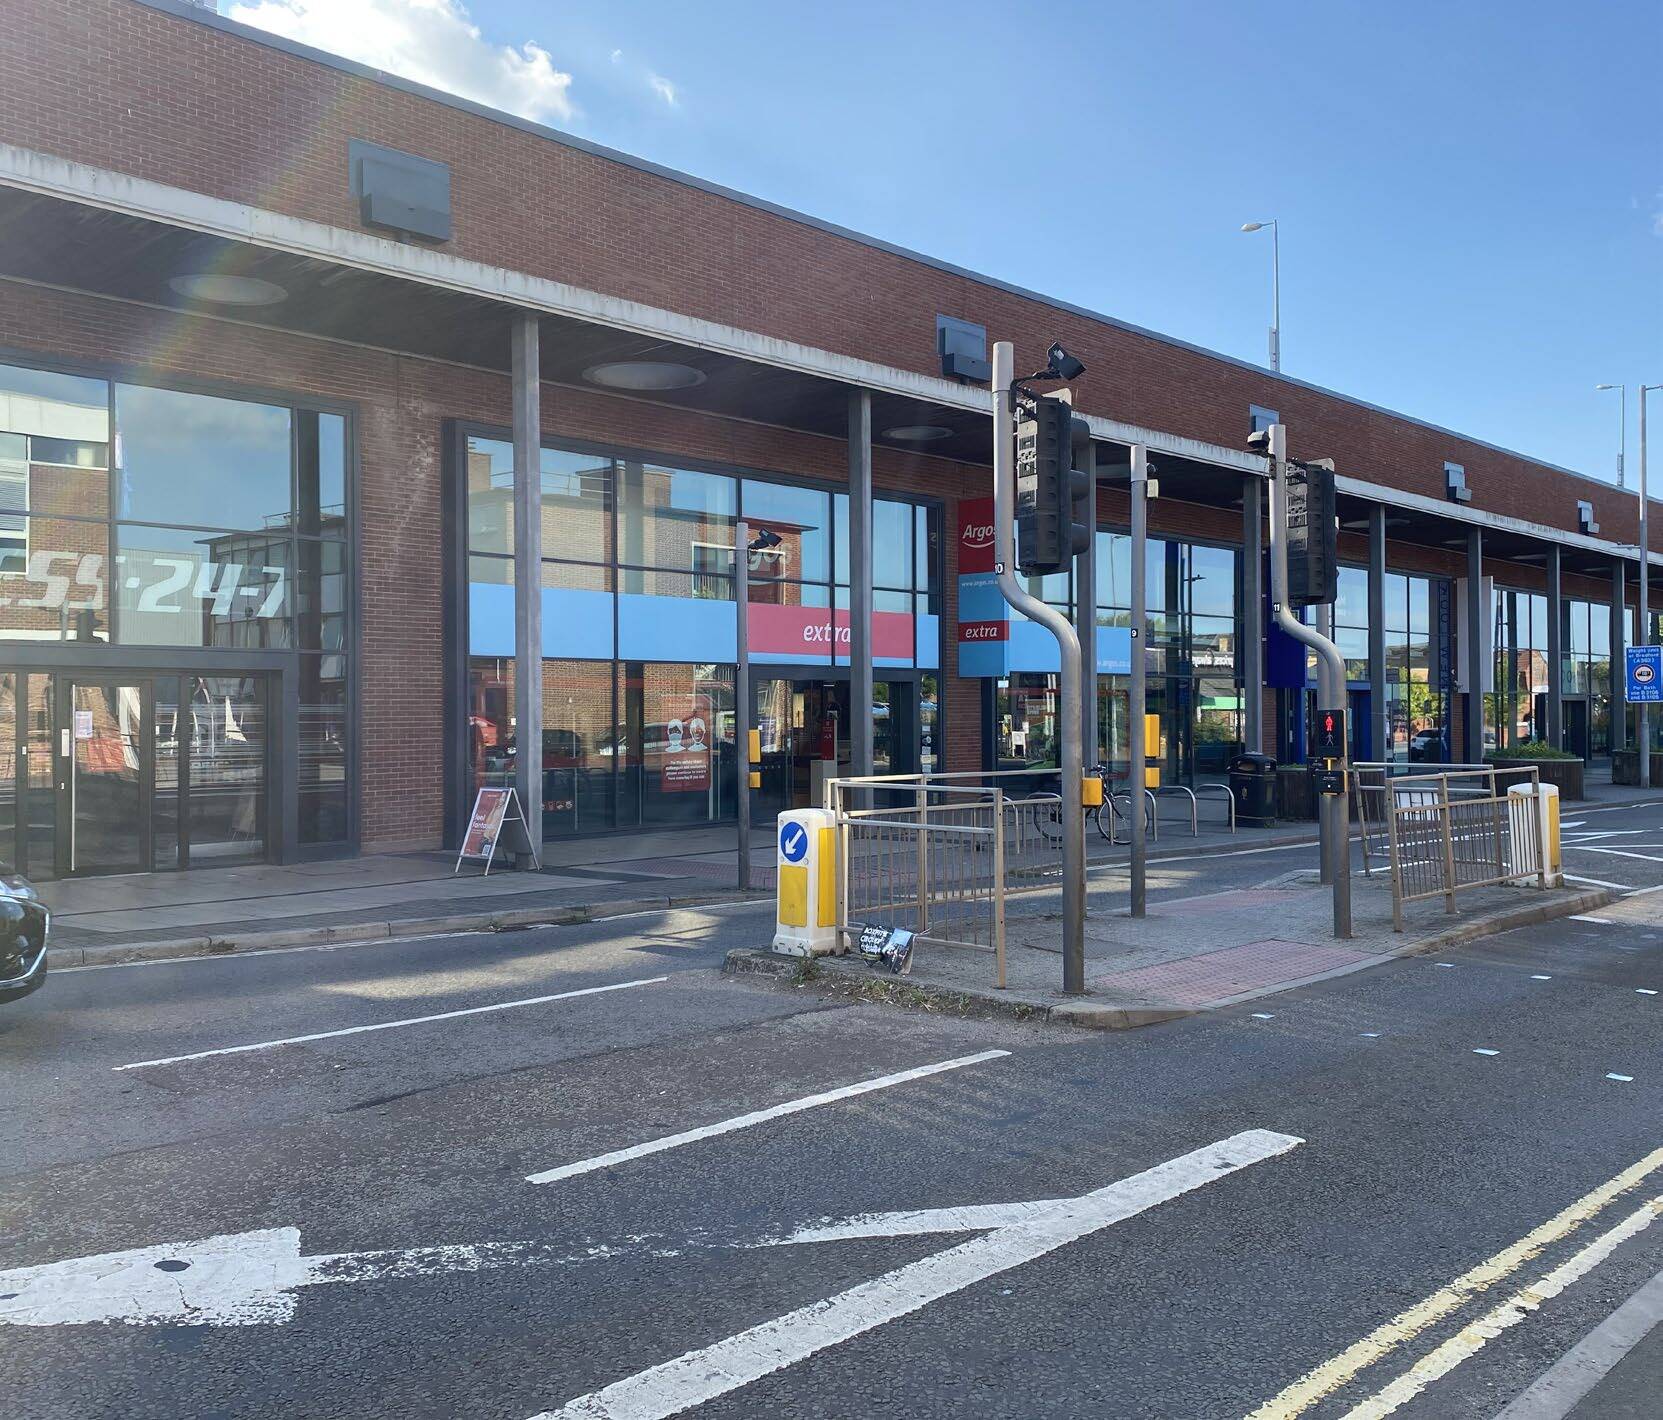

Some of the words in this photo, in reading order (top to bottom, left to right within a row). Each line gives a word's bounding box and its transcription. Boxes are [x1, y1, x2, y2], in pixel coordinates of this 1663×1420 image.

[1273, 603, 1280, 612] 11
[965, 625, 998, 638] extra
[1131, 629, 1138, 638] 9
